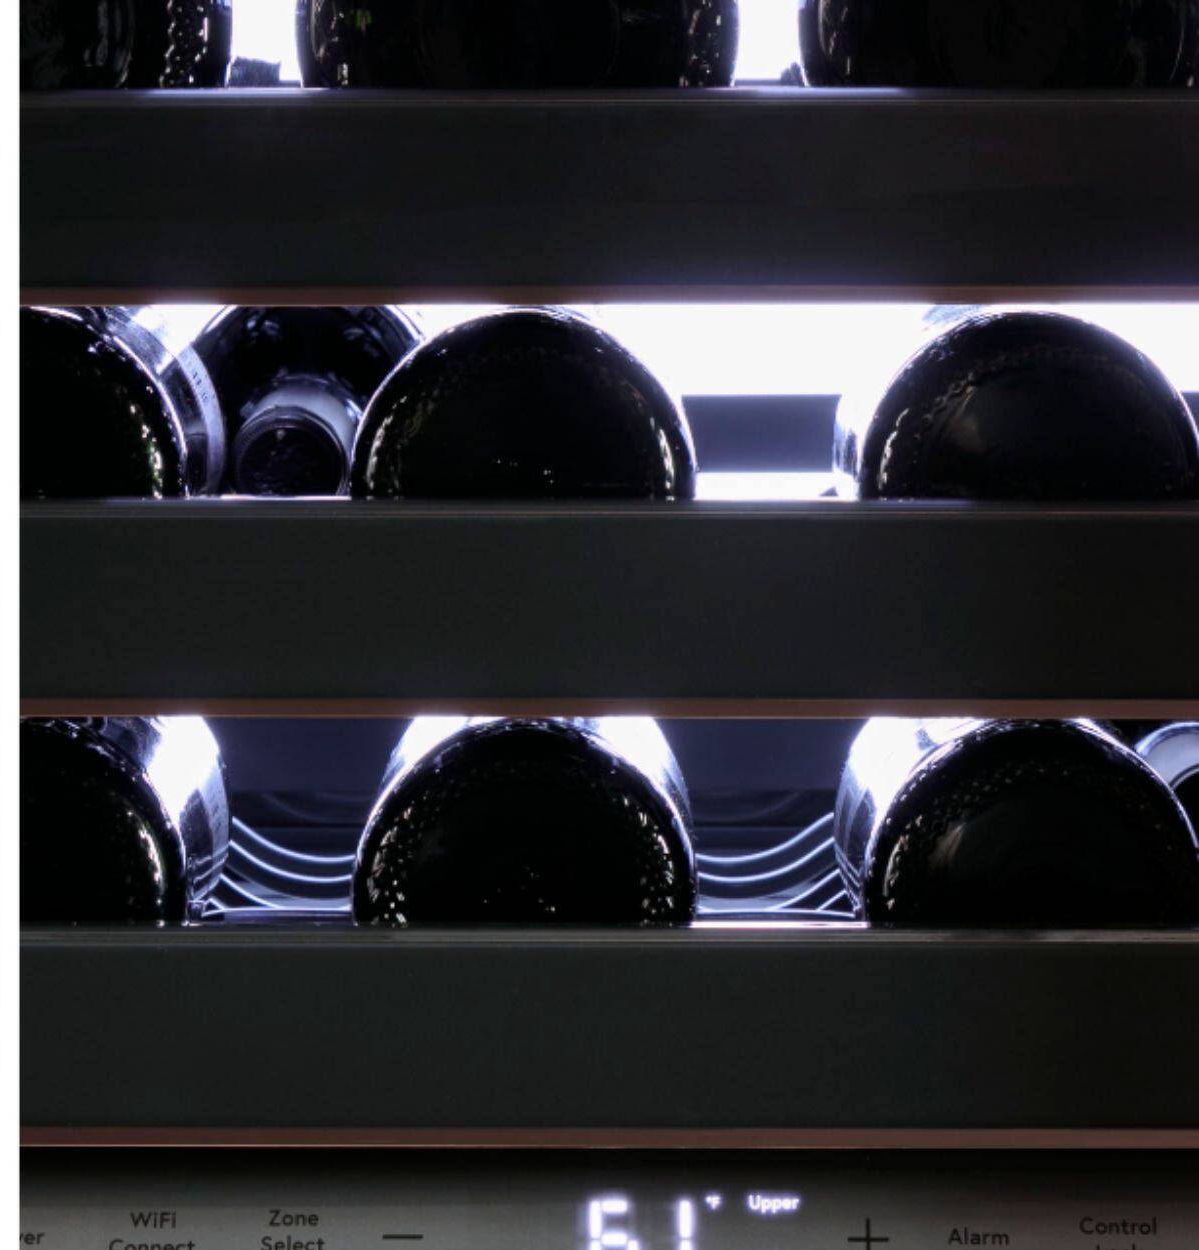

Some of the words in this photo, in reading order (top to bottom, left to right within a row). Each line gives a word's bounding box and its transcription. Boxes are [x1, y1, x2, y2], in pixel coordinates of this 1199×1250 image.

[748, 1195, 800, 1215] Upper
[130, 1212, 177, 1229] WiFi
[268, 1209, 320, 1227] Zone
[1079, 1216, 1158, 1236] Control
[948, 1227, 1011, 1246] Alarm
